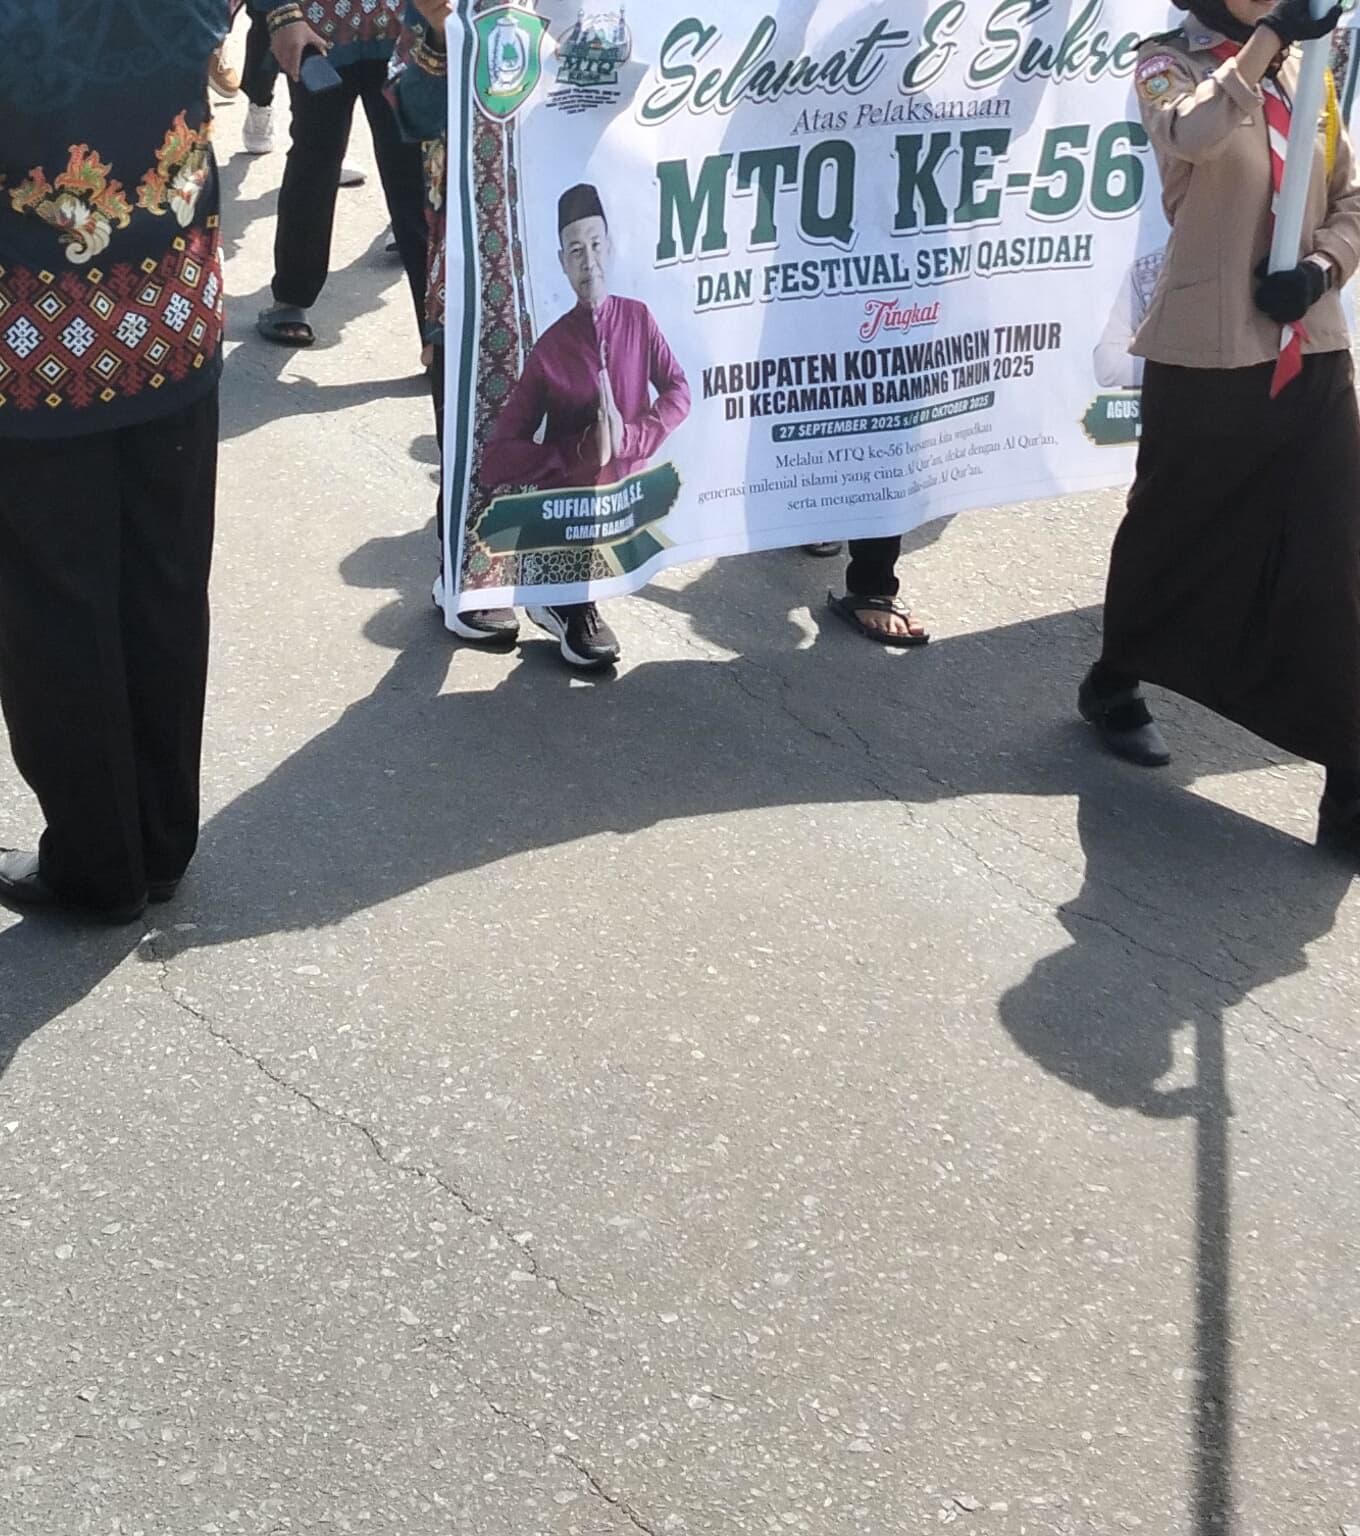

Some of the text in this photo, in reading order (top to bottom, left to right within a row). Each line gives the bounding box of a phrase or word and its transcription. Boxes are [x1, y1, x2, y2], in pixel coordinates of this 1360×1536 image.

[641, 15, 910, 121] Selamat
[791, 97, 1010, 136] Atas Pelaksanaan
[656, 121, 1149, 261] MTQ KE-56
[697, 234, 1093, 305] DAN FESTIVAL SENI QASIDAH
[860, 298, 940, 339] Tingkat
[702, 322, 1062, 399] KABUPATEN KOTAWARINGIN TIMUR
[725, 355, 1034, 421] DI KECAMATAN BAAMANG TAHUN 2025
[779, 425, 795, 439] 27
[798, 420, 868, 437] SEPTEMBER
[871, 416, 900, 433] 2025
[1107, 400, 1140, 419] AGUS
[697, 482, 746, 504] generasi
[749, 476, 798, 494] milenial
[801, 469, 838, 487] islami
[841, 466, 871, 486] yang
[874, 464, 904, 480] cinta
[1003, 436, 1016, 451] Al
[775, 450, 823, 469] Melalui
[827, 447, 865, 464] MTQ
[868, 443, 903, 459] ke-56
[787, 496, 817, 511] serta
[820, 488, 906, 508] mengamalkan
[565, 523, 601, 540] CAMAT
